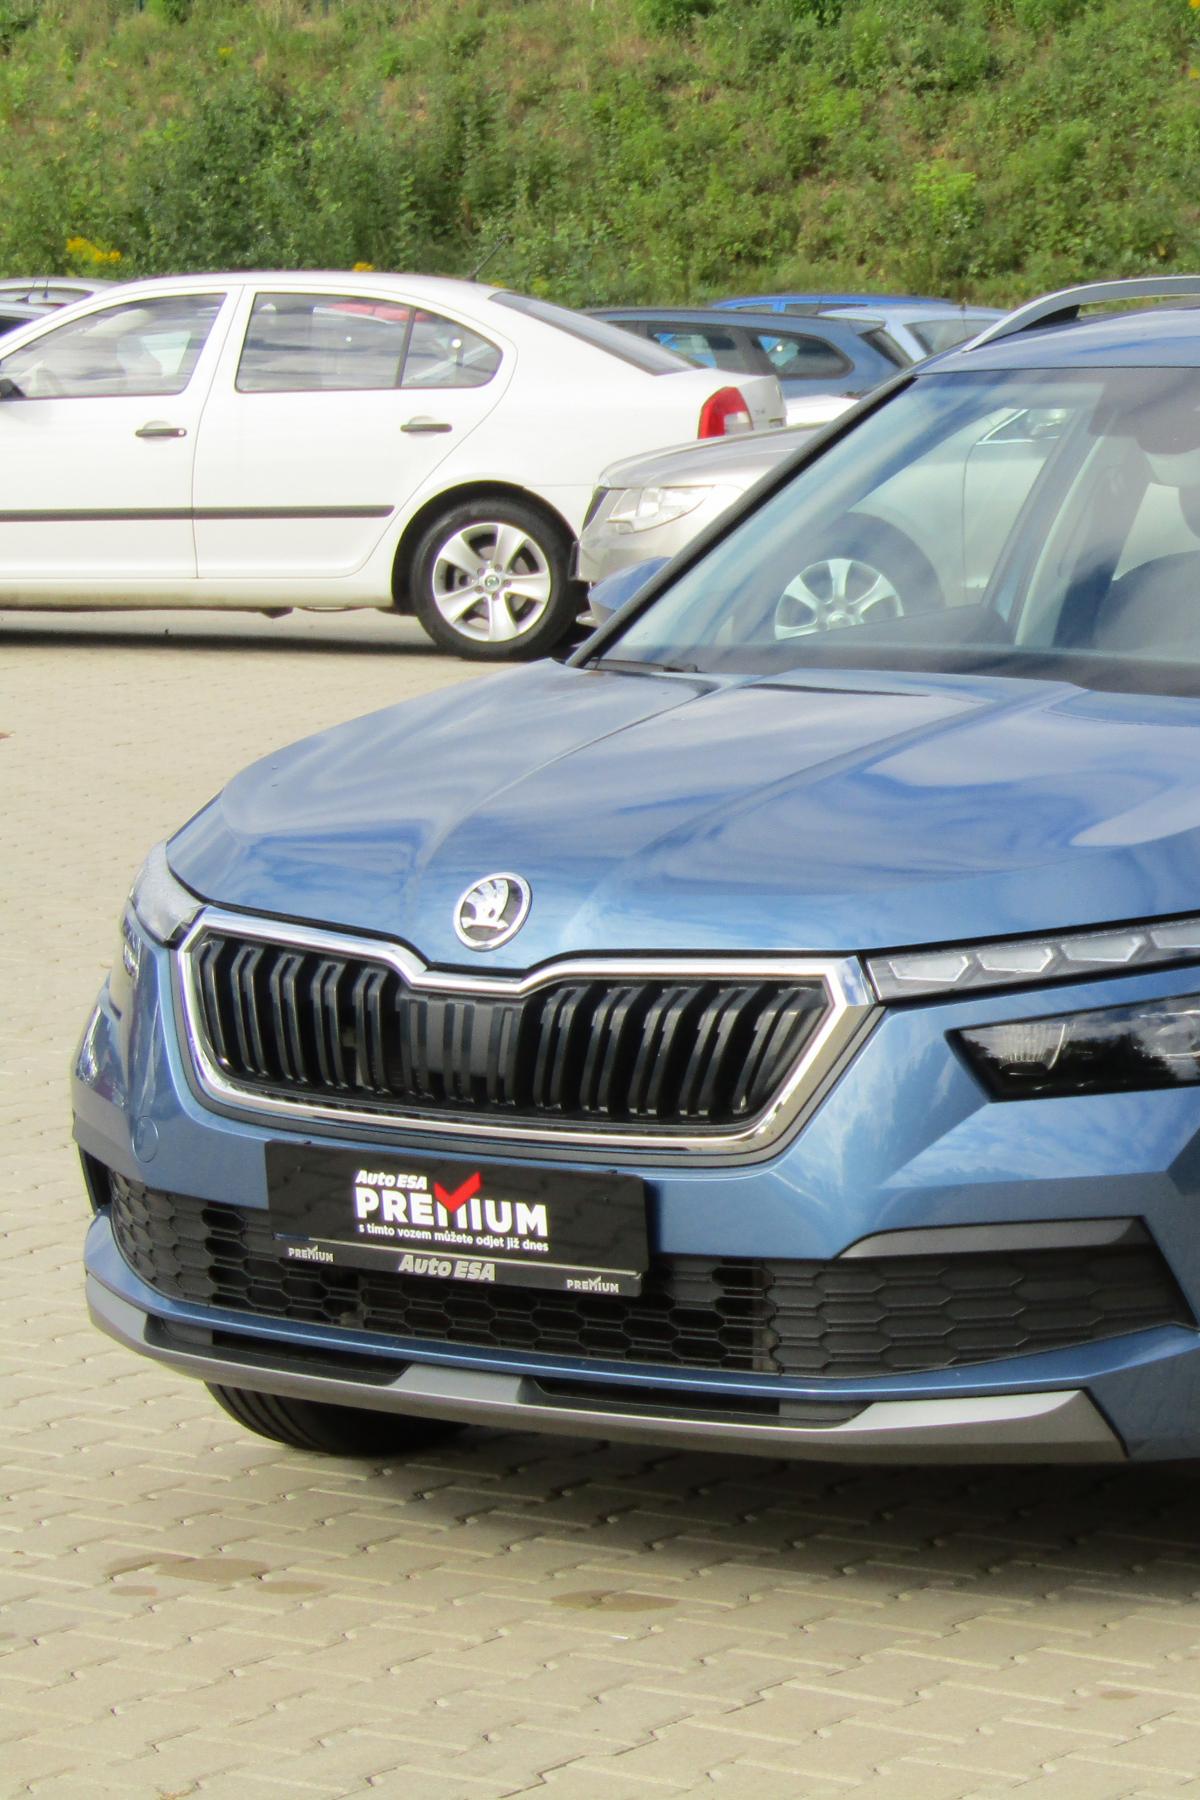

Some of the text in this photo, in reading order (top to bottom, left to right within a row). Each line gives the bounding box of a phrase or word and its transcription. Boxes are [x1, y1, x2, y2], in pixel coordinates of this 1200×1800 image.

[355, 1170, 428, 1190] Auto ESA
[354, 1186, 549, 1237] PREMIUM
[397, 1227, 432, 1240] vozem
[476, 1234, 505, 1248] odjet
[522, 1239, 549, 1252] dnes
[398, 1254, 496, 1282] Auto ESA
